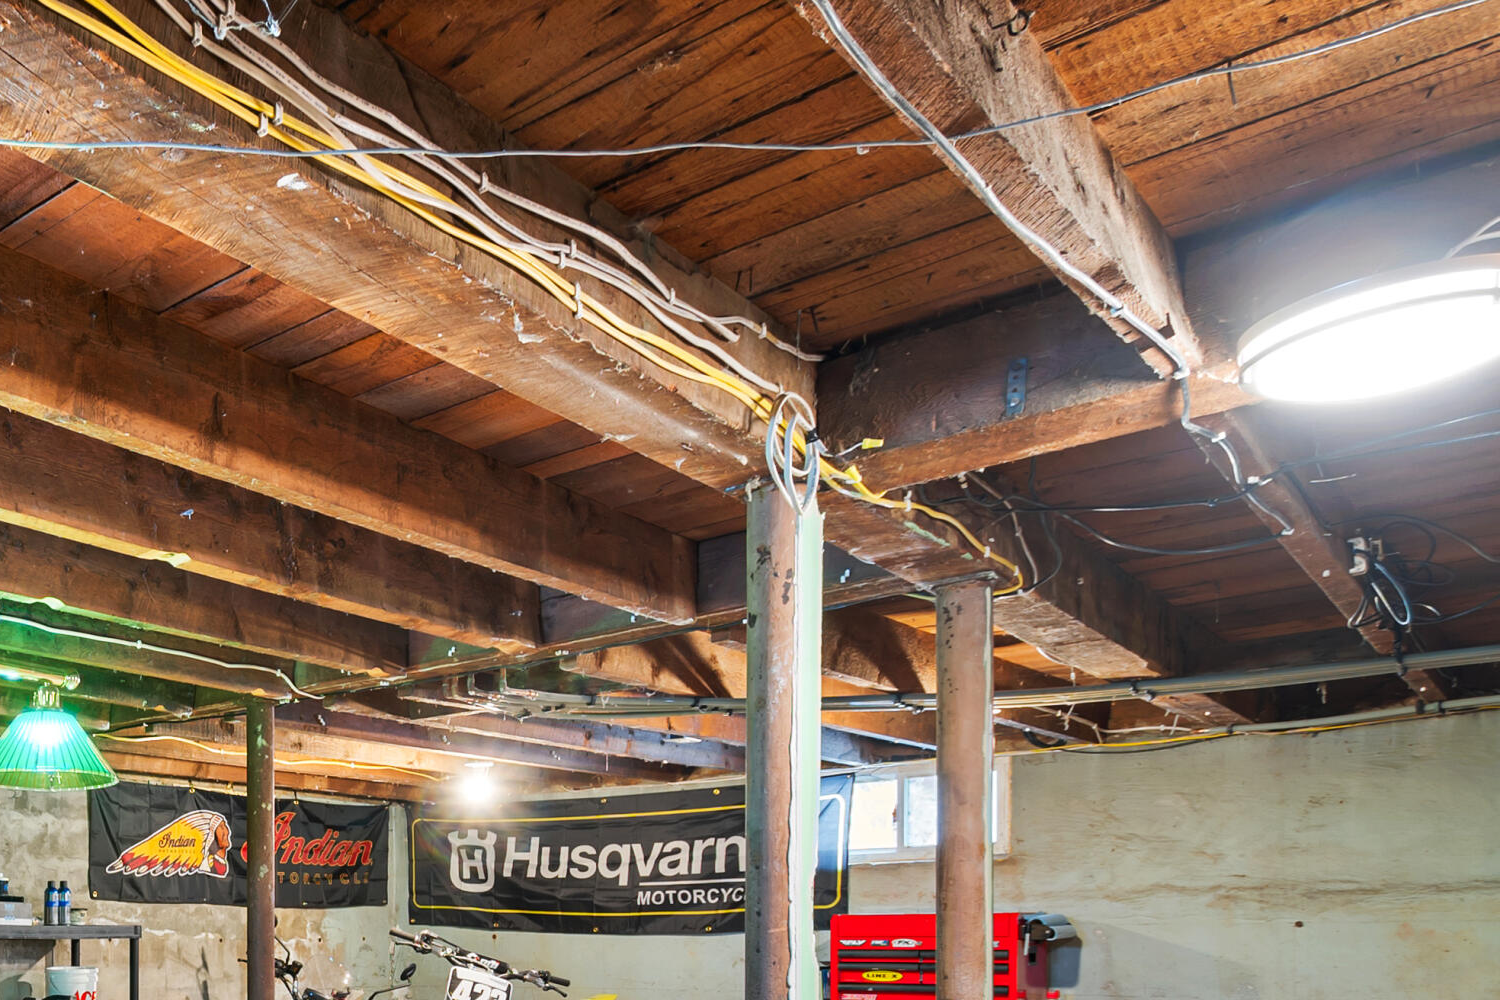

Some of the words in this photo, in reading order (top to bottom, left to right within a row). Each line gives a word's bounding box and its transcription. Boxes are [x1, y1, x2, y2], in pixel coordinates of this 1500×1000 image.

[158, 831, 196, 848] Indian
[502, 835, 746, 886] Husqvarn
[277, 870, 370, 885] TORCYCLE
[636, 887, 747, 906] MOTORCYC
